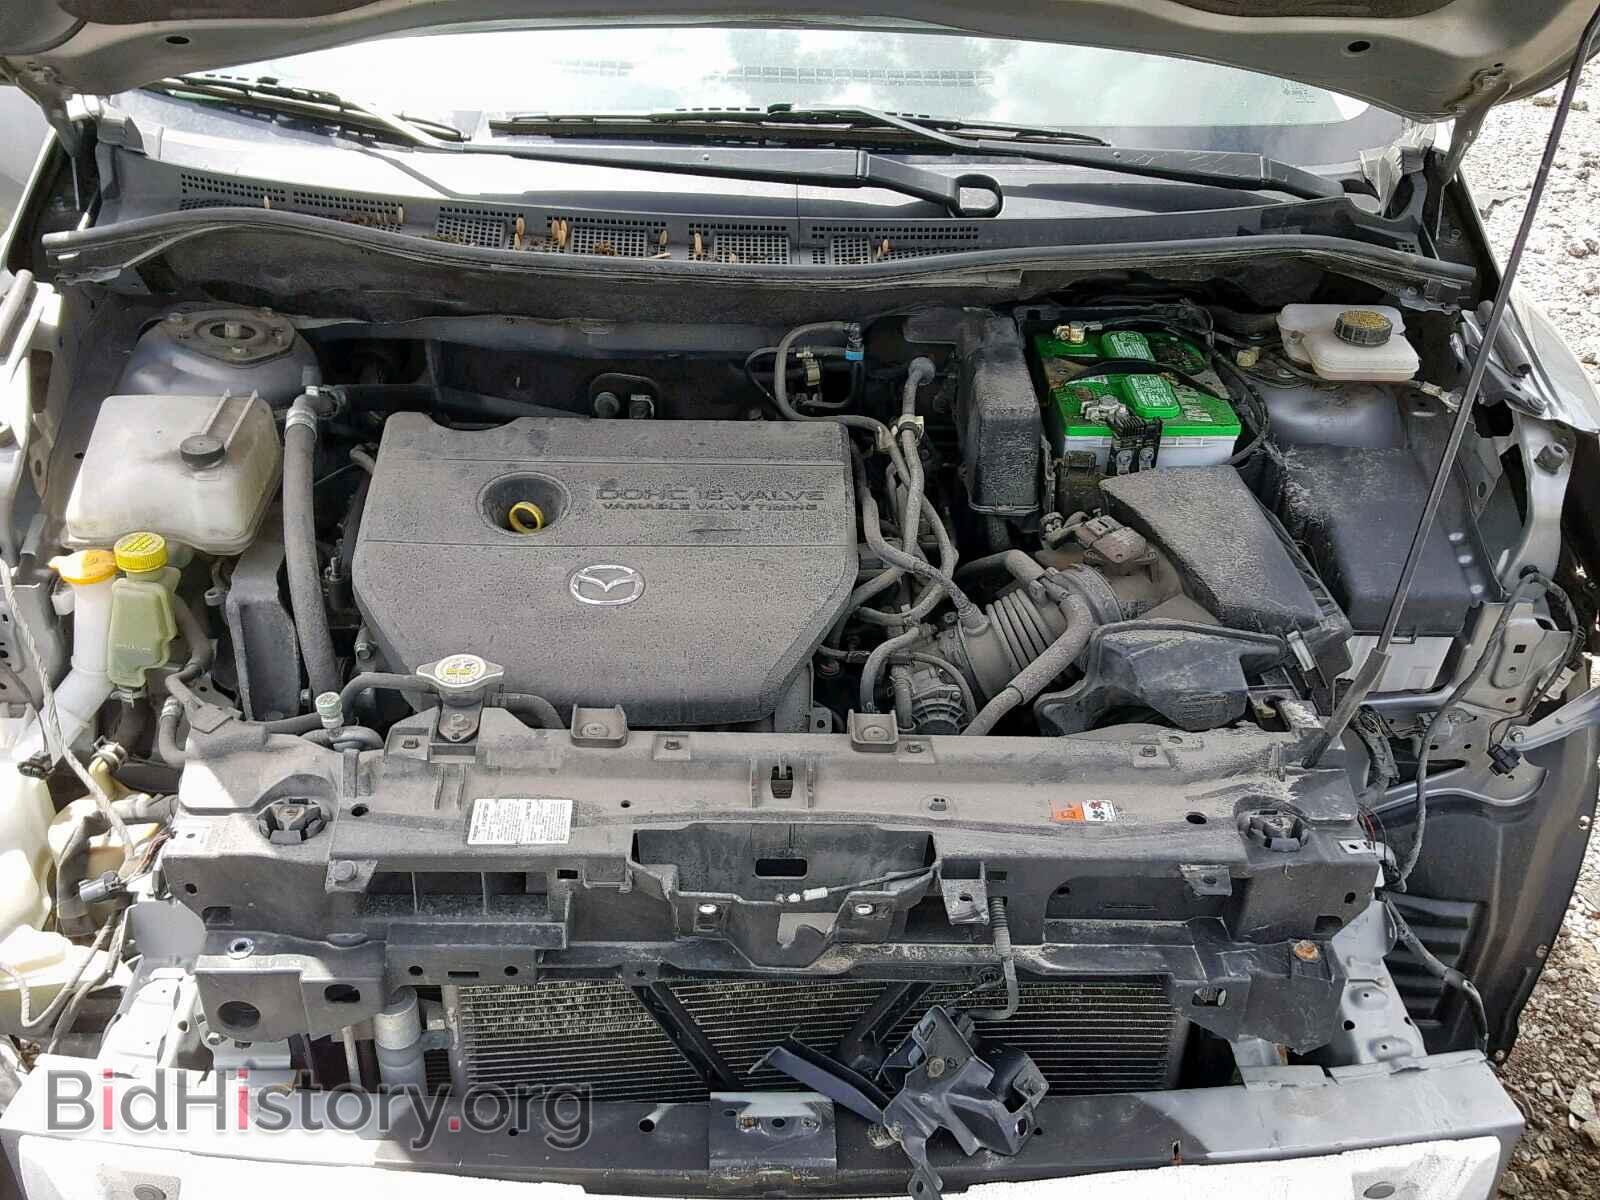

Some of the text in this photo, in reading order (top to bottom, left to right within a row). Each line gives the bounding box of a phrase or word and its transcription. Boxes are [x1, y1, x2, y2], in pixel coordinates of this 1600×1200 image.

[596, 488, 825, 501] DOHC 16-VALVE
[601, 502, 818, 511] VARIABLE VALVE TIMING
